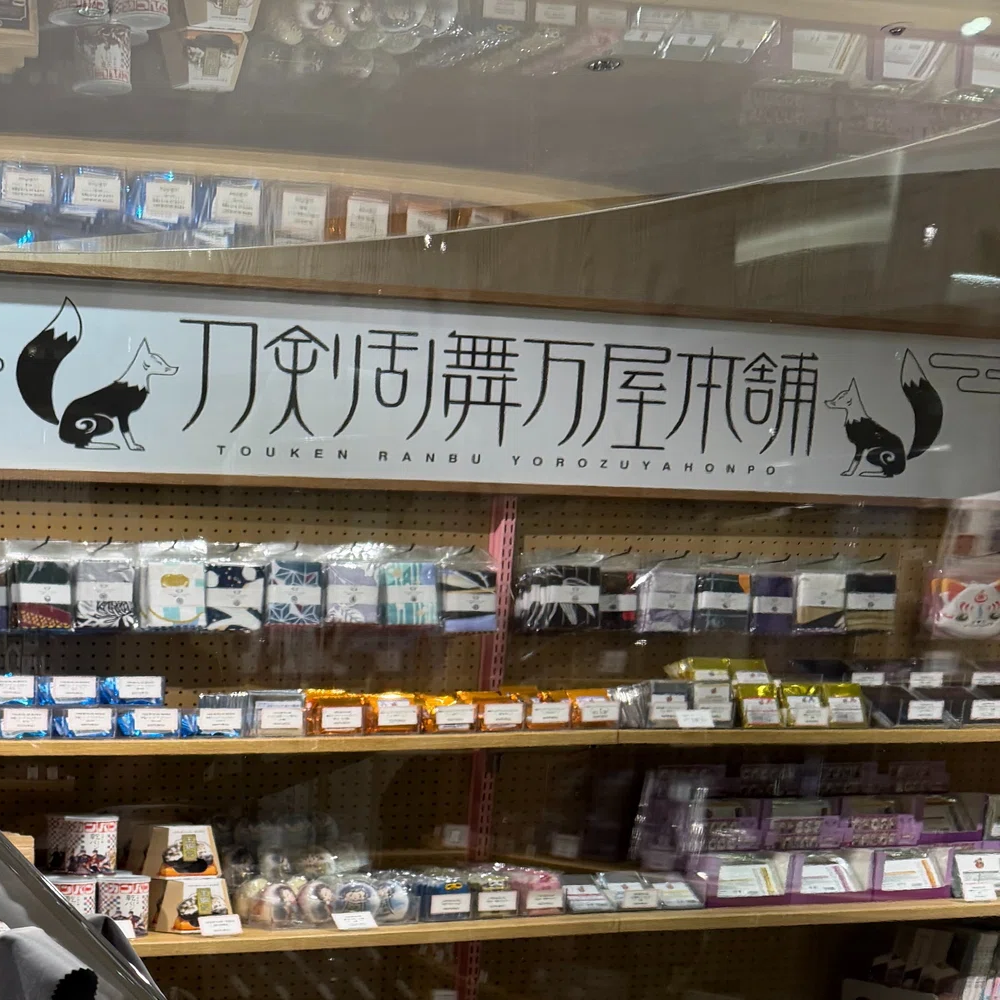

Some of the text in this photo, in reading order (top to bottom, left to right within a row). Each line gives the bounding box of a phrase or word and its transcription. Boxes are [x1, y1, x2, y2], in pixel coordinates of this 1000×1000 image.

[180, 318, 819, 456] 刀剣乱舞万屋本舗
[217, 445, 775, 475] TOUKEN RANBU YOROZUYAHONPO
